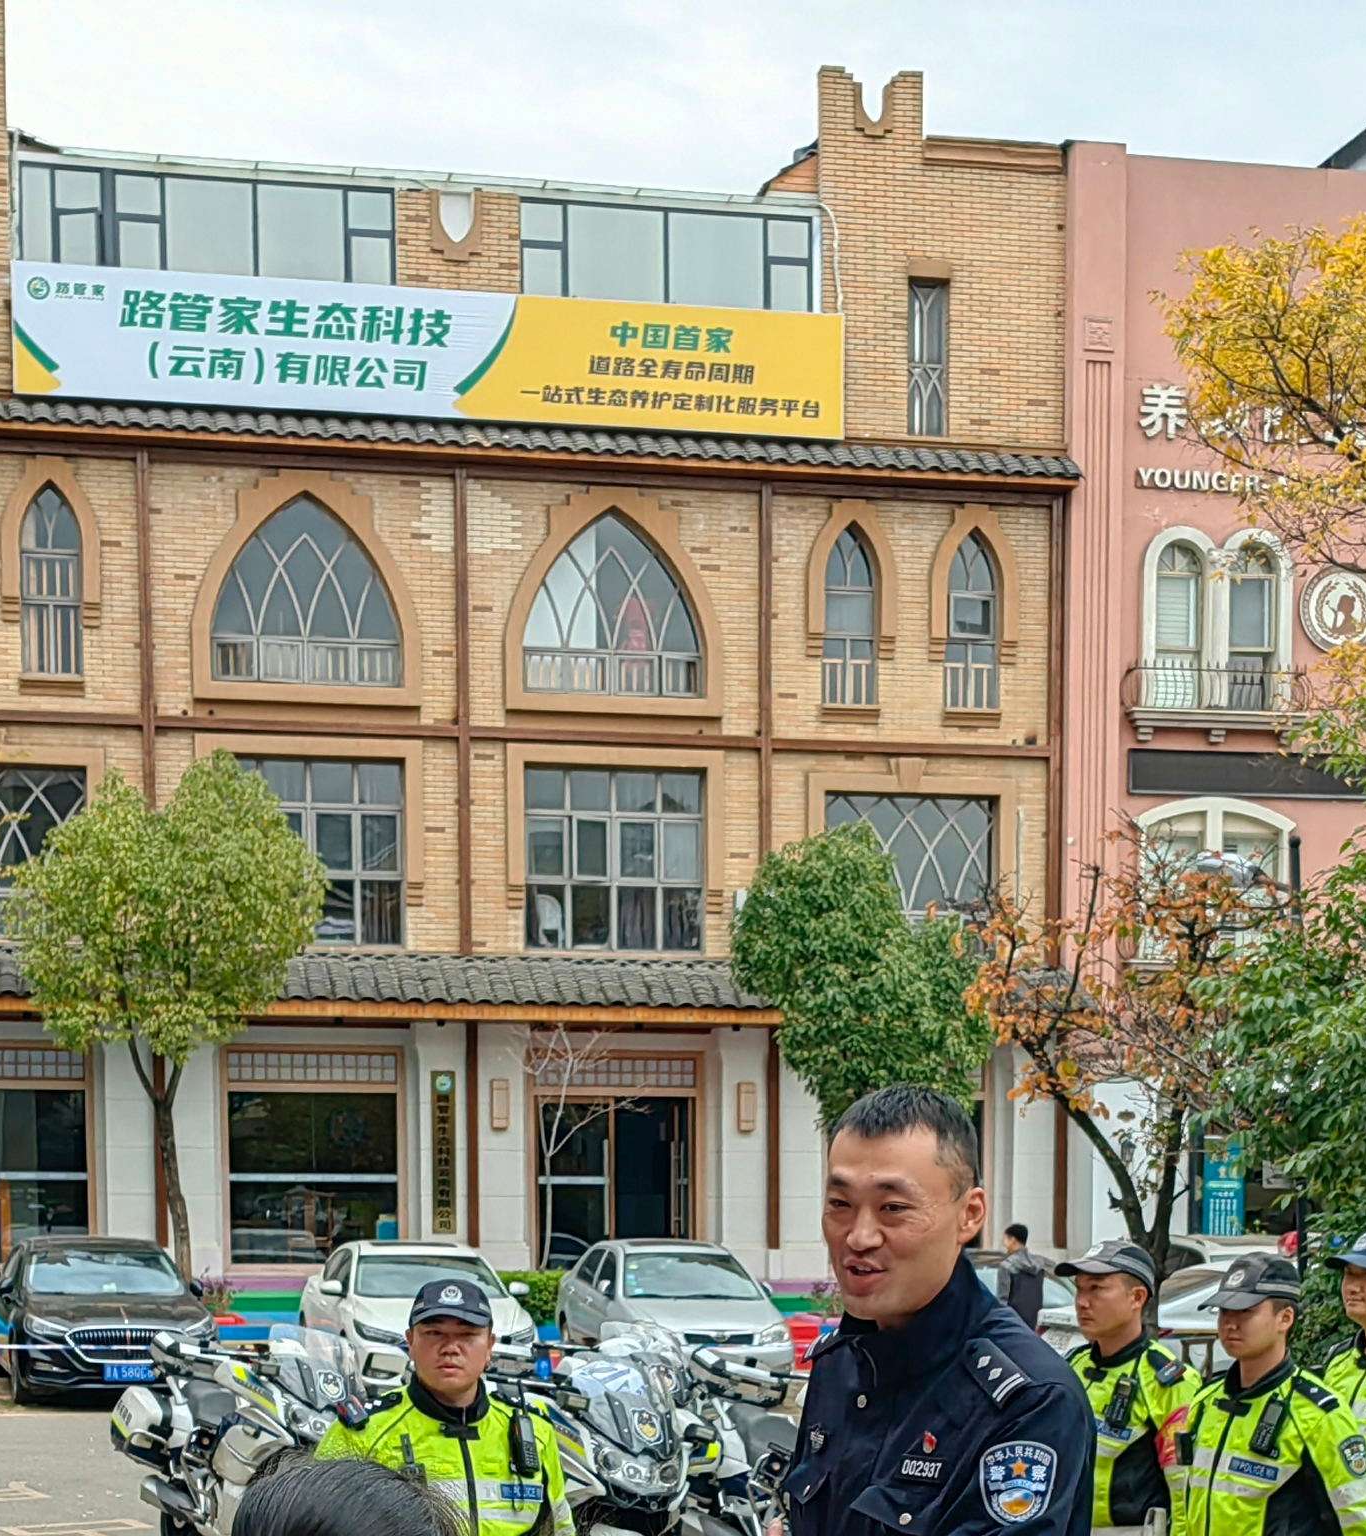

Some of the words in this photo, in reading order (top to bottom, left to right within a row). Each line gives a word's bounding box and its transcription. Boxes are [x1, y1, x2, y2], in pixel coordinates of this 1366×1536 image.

[119, 289, 452, 348] 路管家生态科技
[610, 321, 734, 353] 中国首家
[148, 341, 428, 391] （云南）有限公司
[588, 355, 754, 384] 道路全寿命周期
[520, 385, 820, 418] 一站式生态养护定制化服务平台
